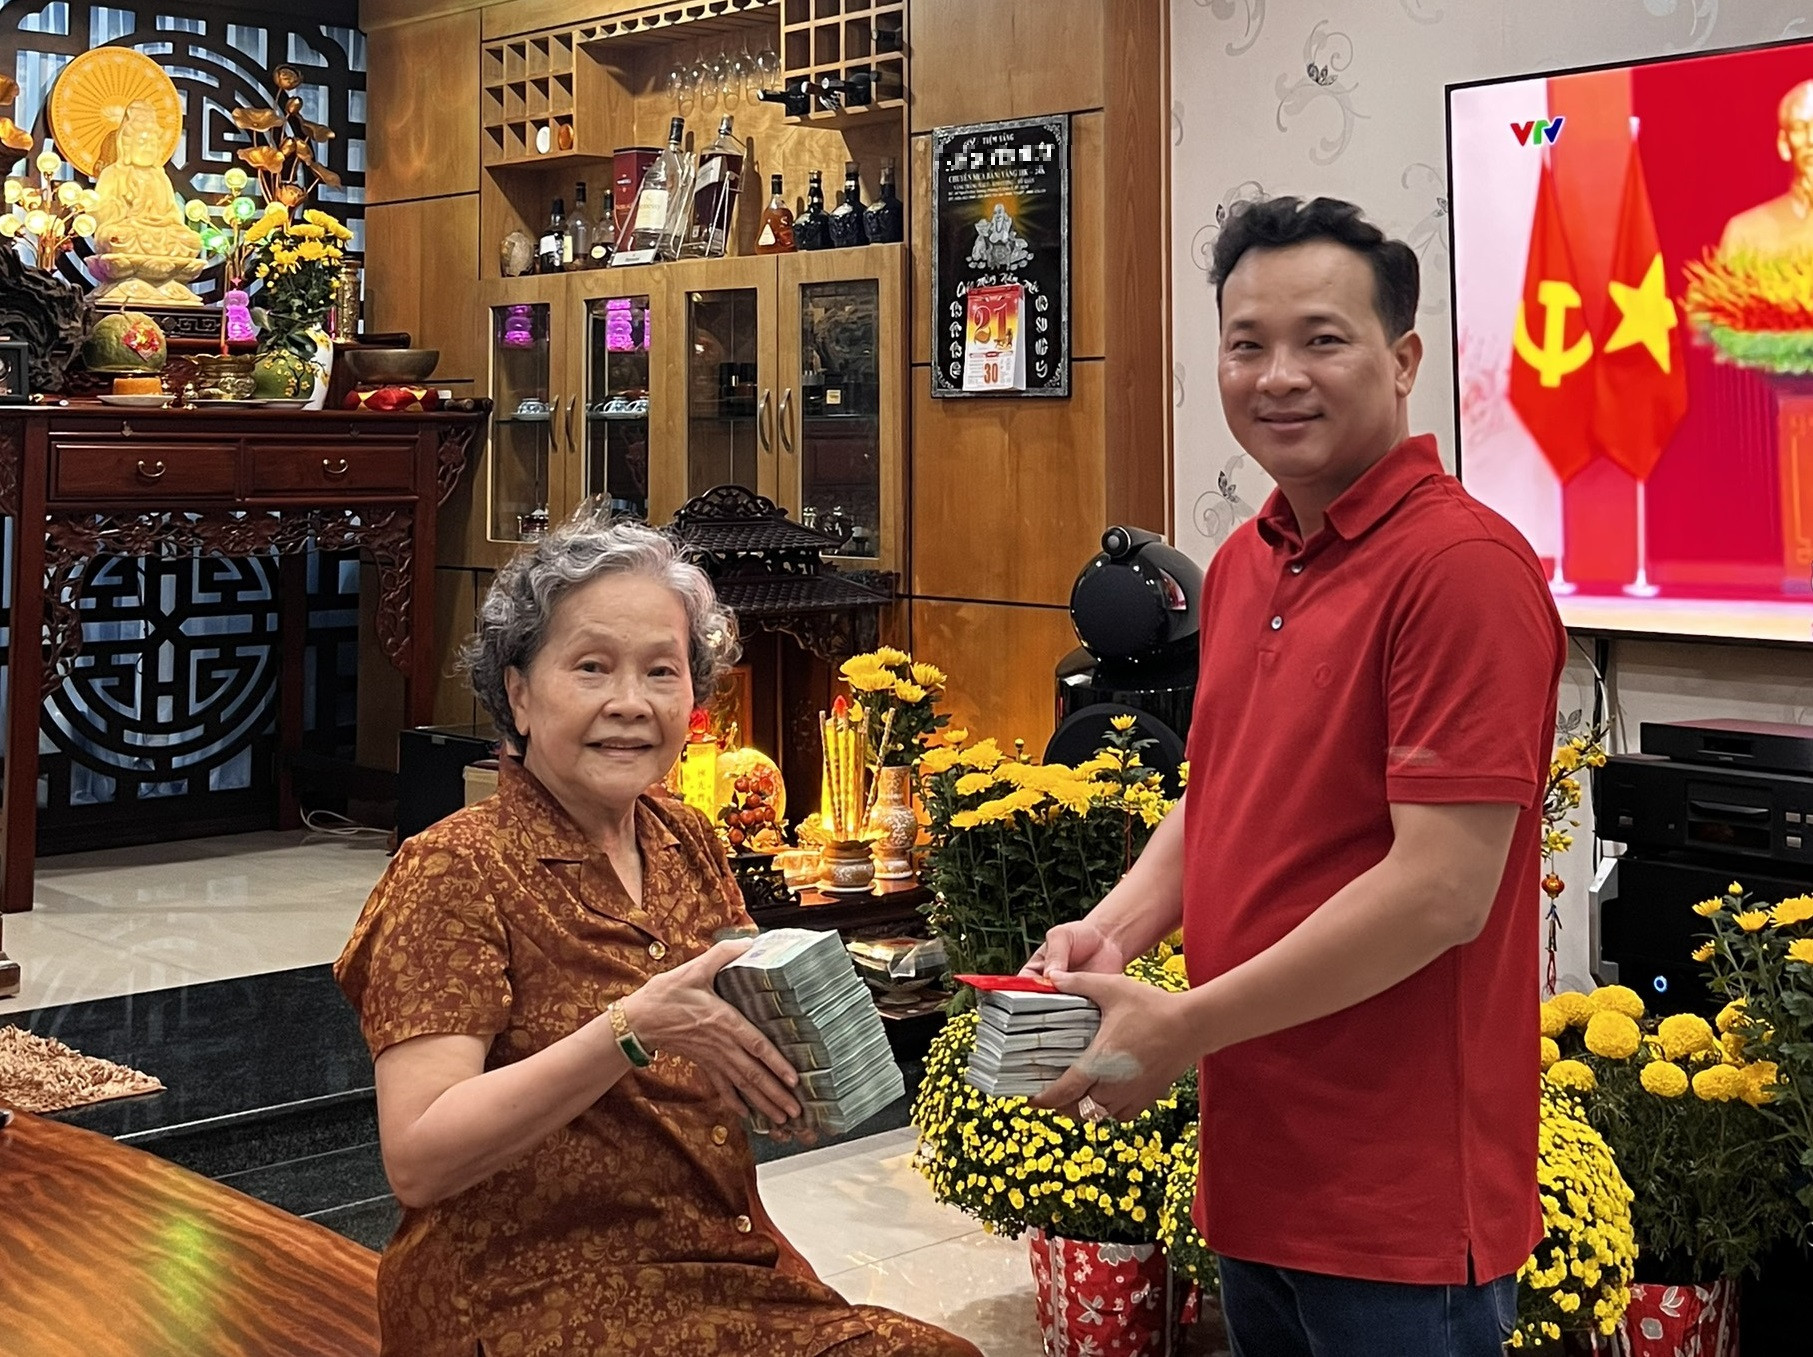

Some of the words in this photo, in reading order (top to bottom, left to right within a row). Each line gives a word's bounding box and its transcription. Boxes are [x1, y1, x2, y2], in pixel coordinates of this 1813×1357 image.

[1510, 118, 1564, 147] VTV
[973, 302, 1008, 344] 21
[984, 363, 999, 384] 30
